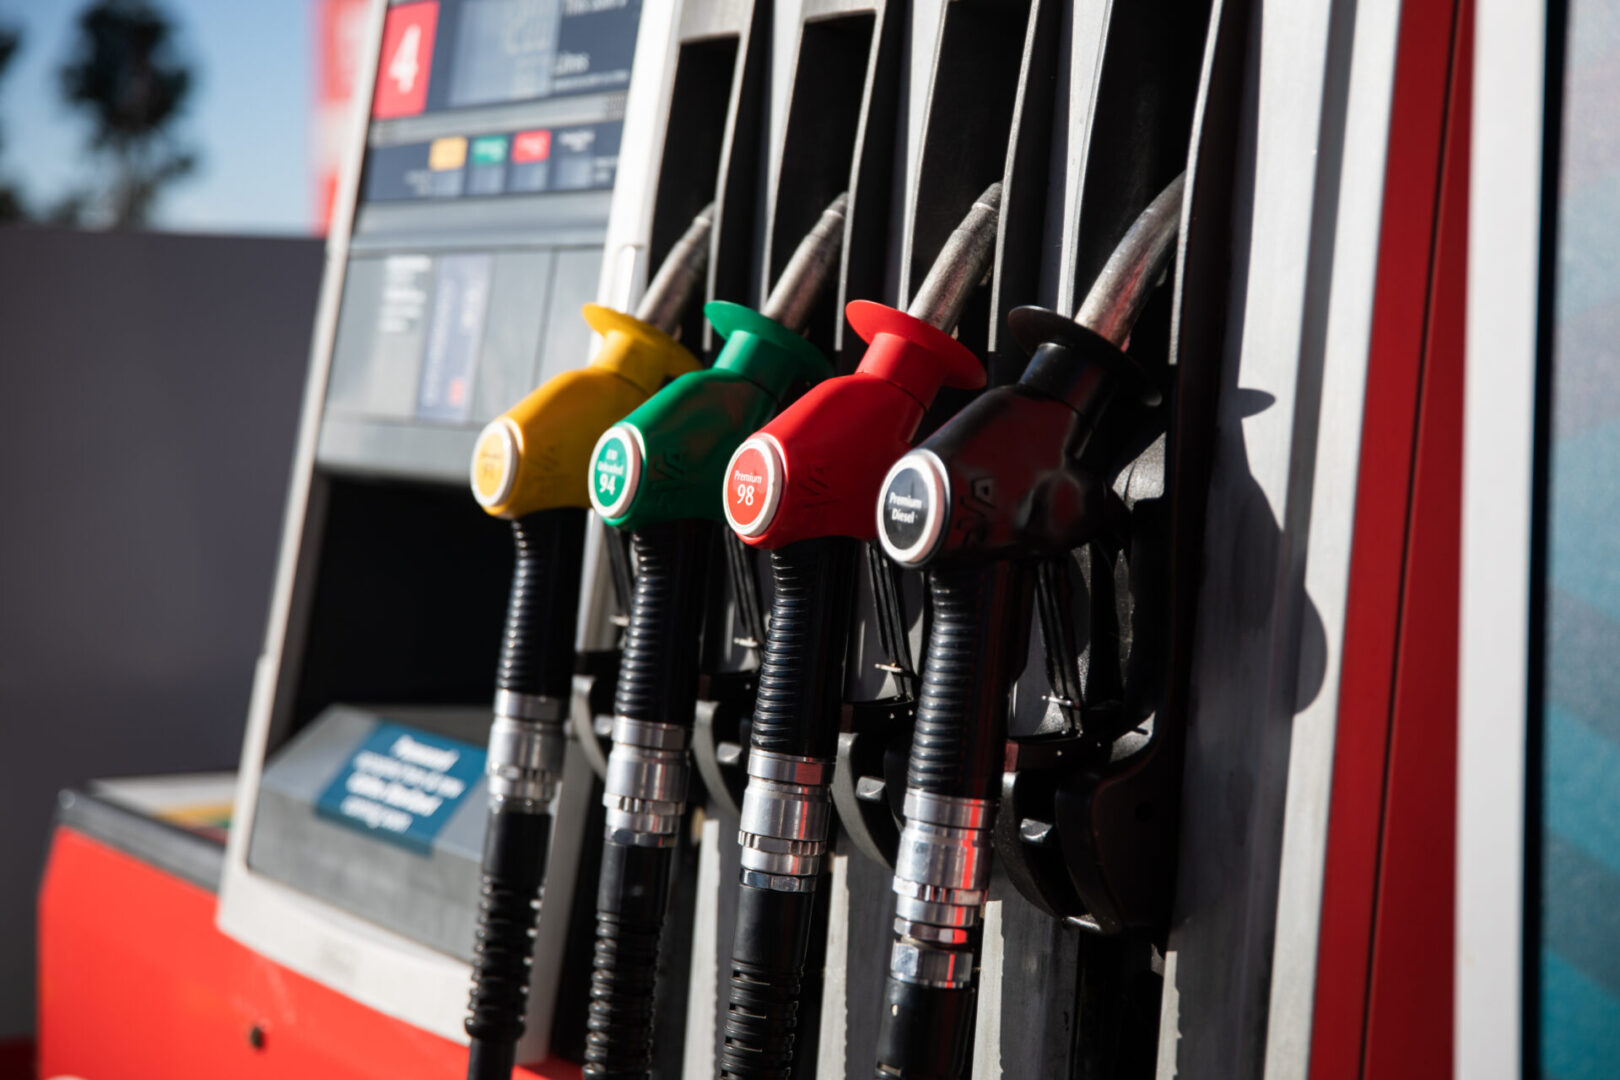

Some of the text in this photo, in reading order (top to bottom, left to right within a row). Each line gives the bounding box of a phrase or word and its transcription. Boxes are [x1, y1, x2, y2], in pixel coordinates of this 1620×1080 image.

[388, 23, 422, 94] 4
[599, 473, 617, 496] 94
[734, 470, 762, 484] Premium
[736, 483, 755, 506] 98
[889, 491, 922, 509] Premium
[891, 508, 915, 524] Diesel
